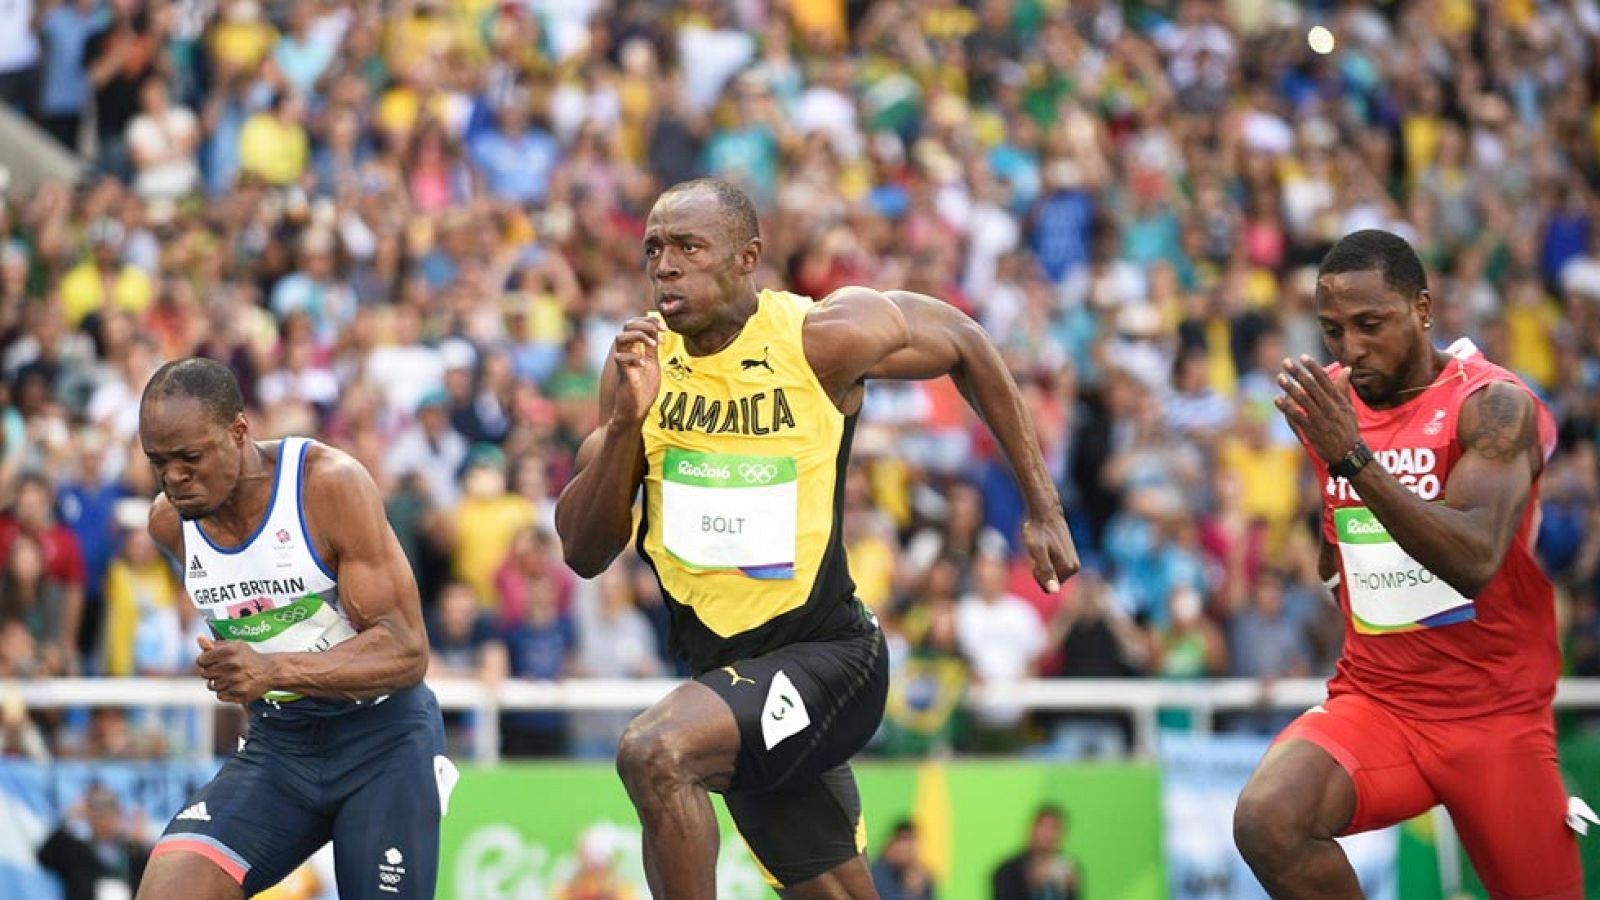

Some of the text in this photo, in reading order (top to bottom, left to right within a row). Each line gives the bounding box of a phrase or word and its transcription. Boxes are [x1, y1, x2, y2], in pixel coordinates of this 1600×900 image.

[659, 388, 796, 435] JAMAICA
[678, 460, 731, 480] Rio2016
[701, 515, 746, 534] BOLT
[194, 576, 305, 605] GREAT BRITAIN
[1352, 567, 1435, 591] THOMPSO
